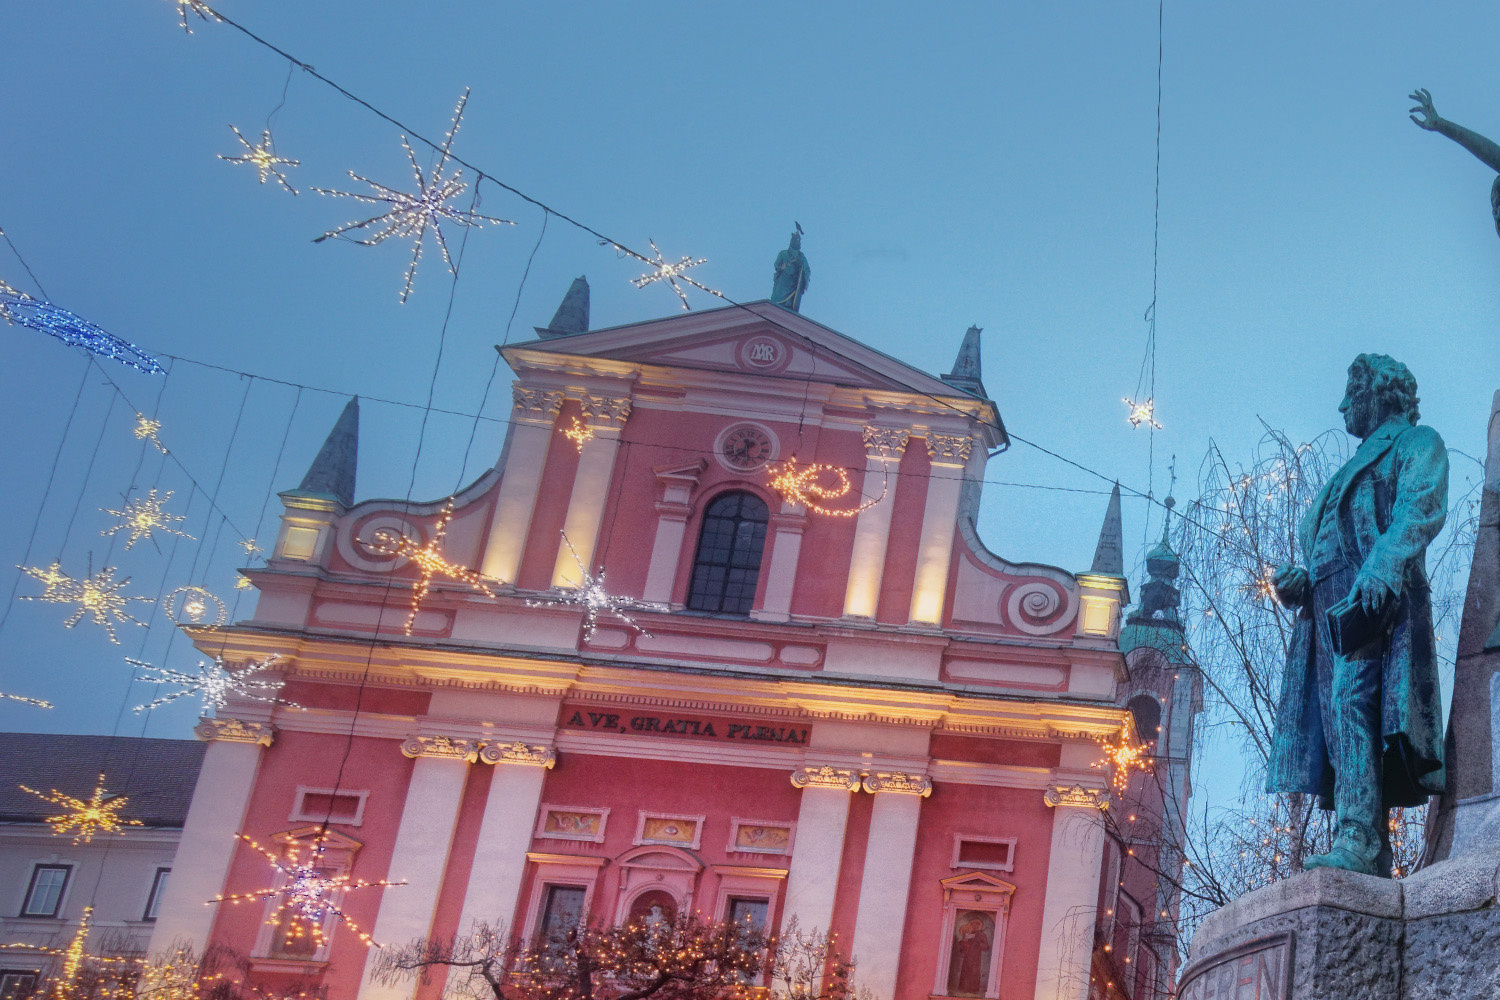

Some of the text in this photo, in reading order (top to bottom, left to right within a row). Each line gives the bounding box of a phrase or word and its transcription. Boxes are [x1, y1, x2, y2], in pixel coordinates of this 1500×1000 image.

[567, 711, 808, 744] AVE, GRATIA PLENA!
